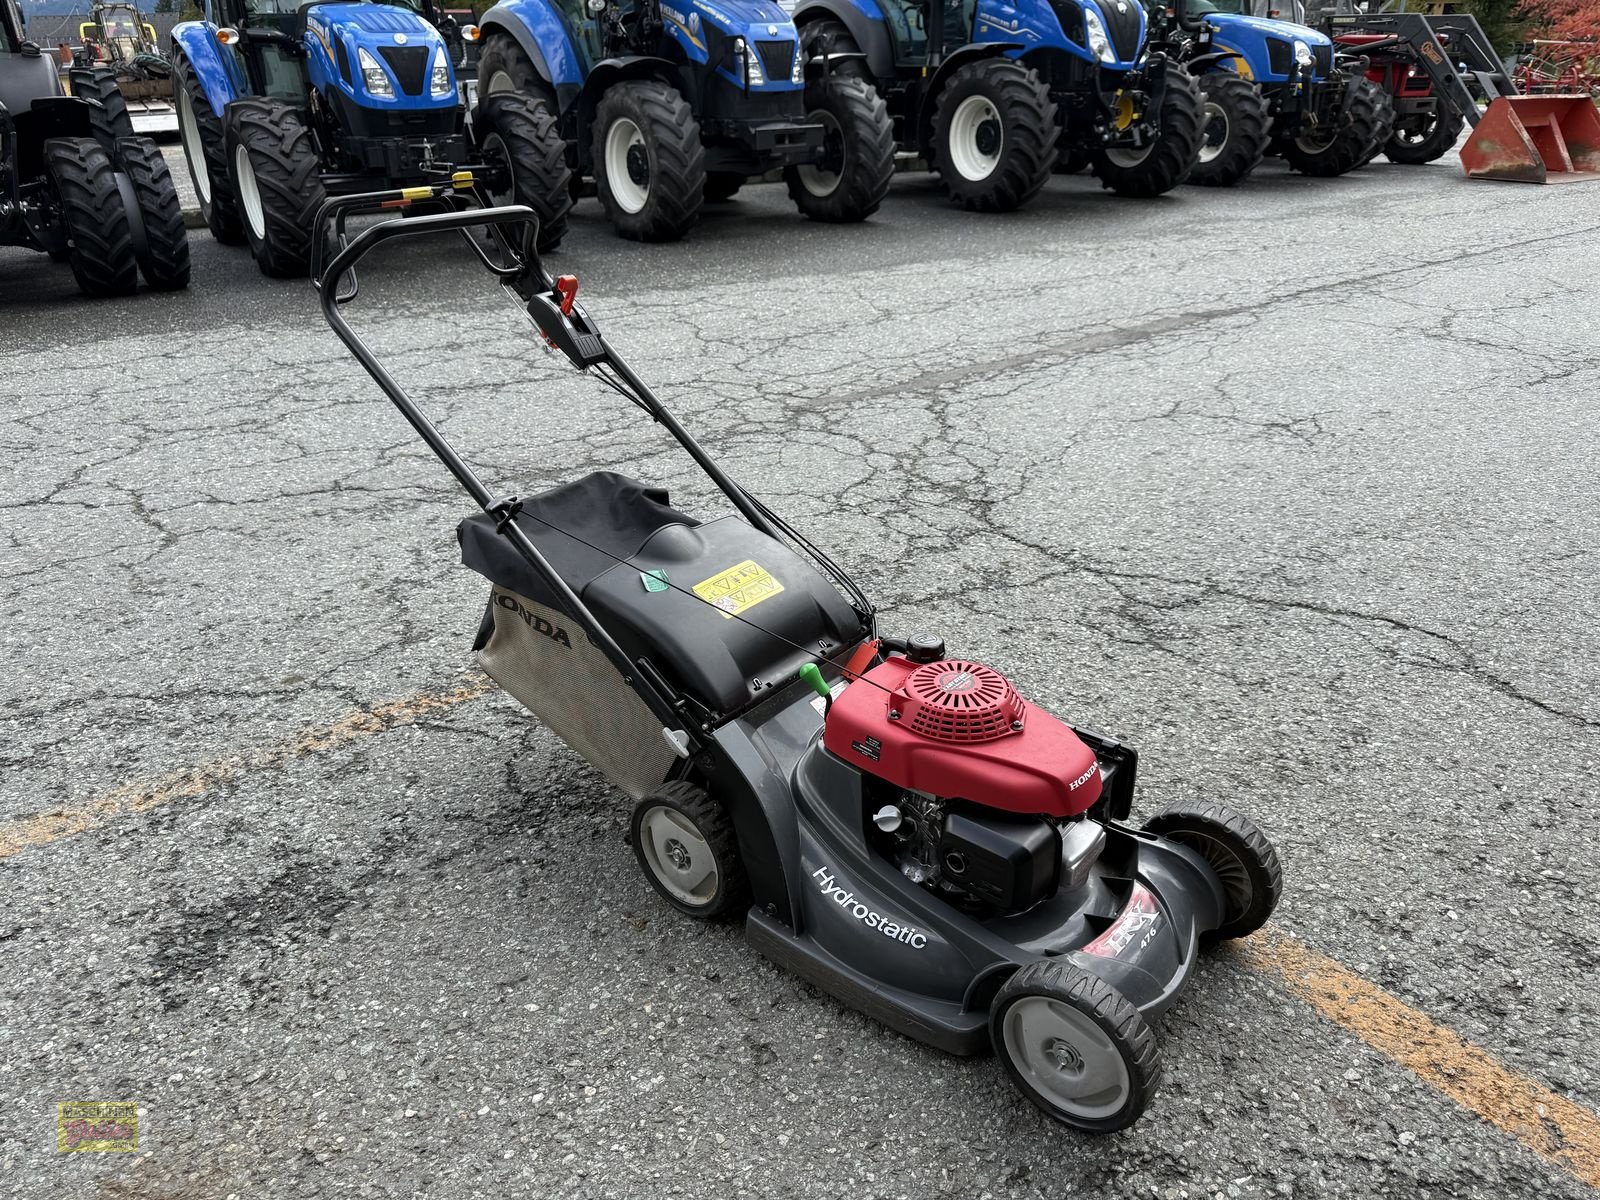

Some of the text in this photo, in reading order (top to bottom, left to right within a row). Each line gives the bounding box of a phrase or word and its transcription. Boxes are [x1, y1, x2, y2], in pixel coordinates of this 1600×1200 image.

[812, 866, 927, 949] Hydrostatic
[1103, 899, 1161, 957] HRX
[1140, 927, 1157, 949] 476
